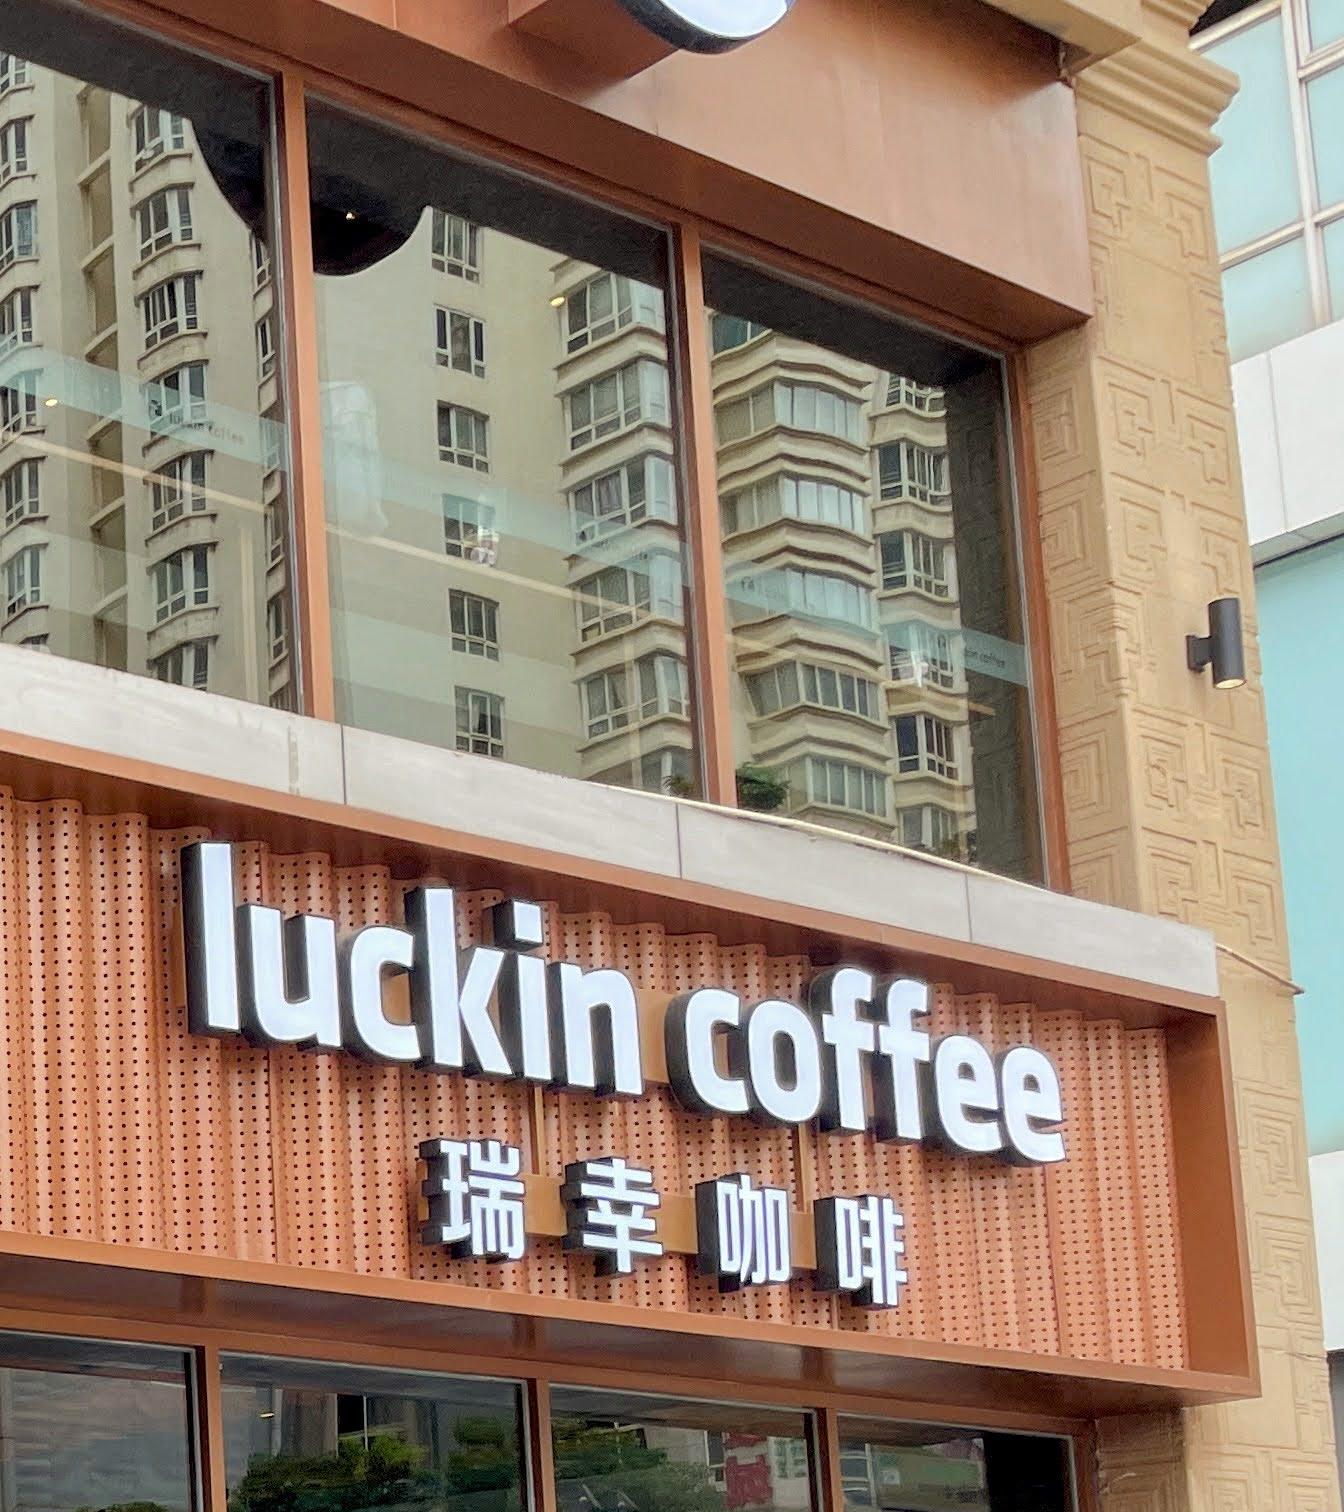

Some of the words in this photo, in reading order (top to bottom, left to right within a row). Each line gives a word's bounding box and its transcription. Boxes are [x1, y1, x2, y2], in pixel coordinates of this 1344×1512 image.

[199, 842, 645, 1096] luckin
[685, 966, 1067, 1163] coffee
[439, 1139, 909, 1307] 瑞幸咖啡
